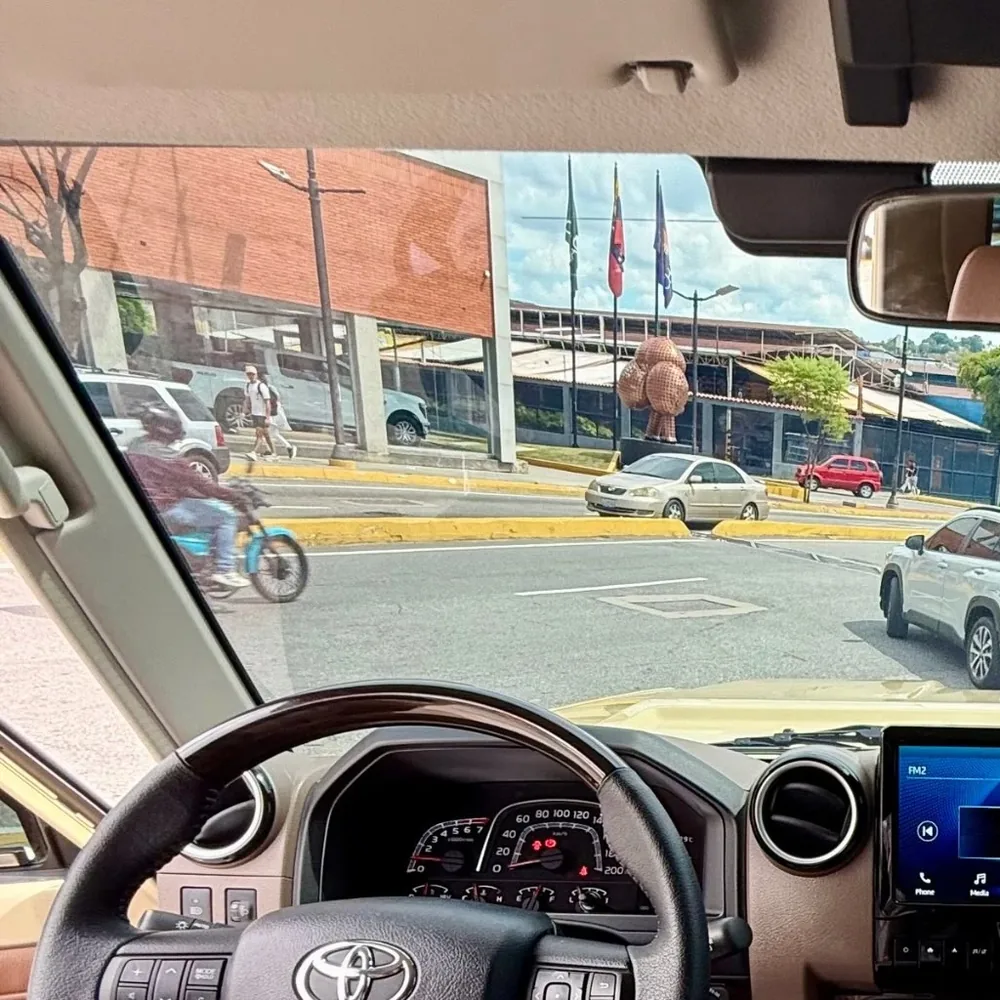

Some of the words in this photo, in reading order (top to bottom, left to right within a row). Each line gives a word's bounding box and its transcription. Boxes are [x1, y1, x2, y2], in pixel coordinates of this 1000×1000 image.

[908, 766, 927, 775] FM2
[535, 809, 549, 818] 80
[553, 809, 570, 818] 100
[573, 810, 590, 819] 120
[516, 815, 530, 823] 60
[502, 830, 516, 838] 40
[496, 847, 510, 856] 20
[417, 865, 425, 873] 0
[492, 864, 502, 873] 0
[604, 866, 624, 875] 200
[915, 888, 935, 896] Phone
[970, 889, 989, 897] Media
